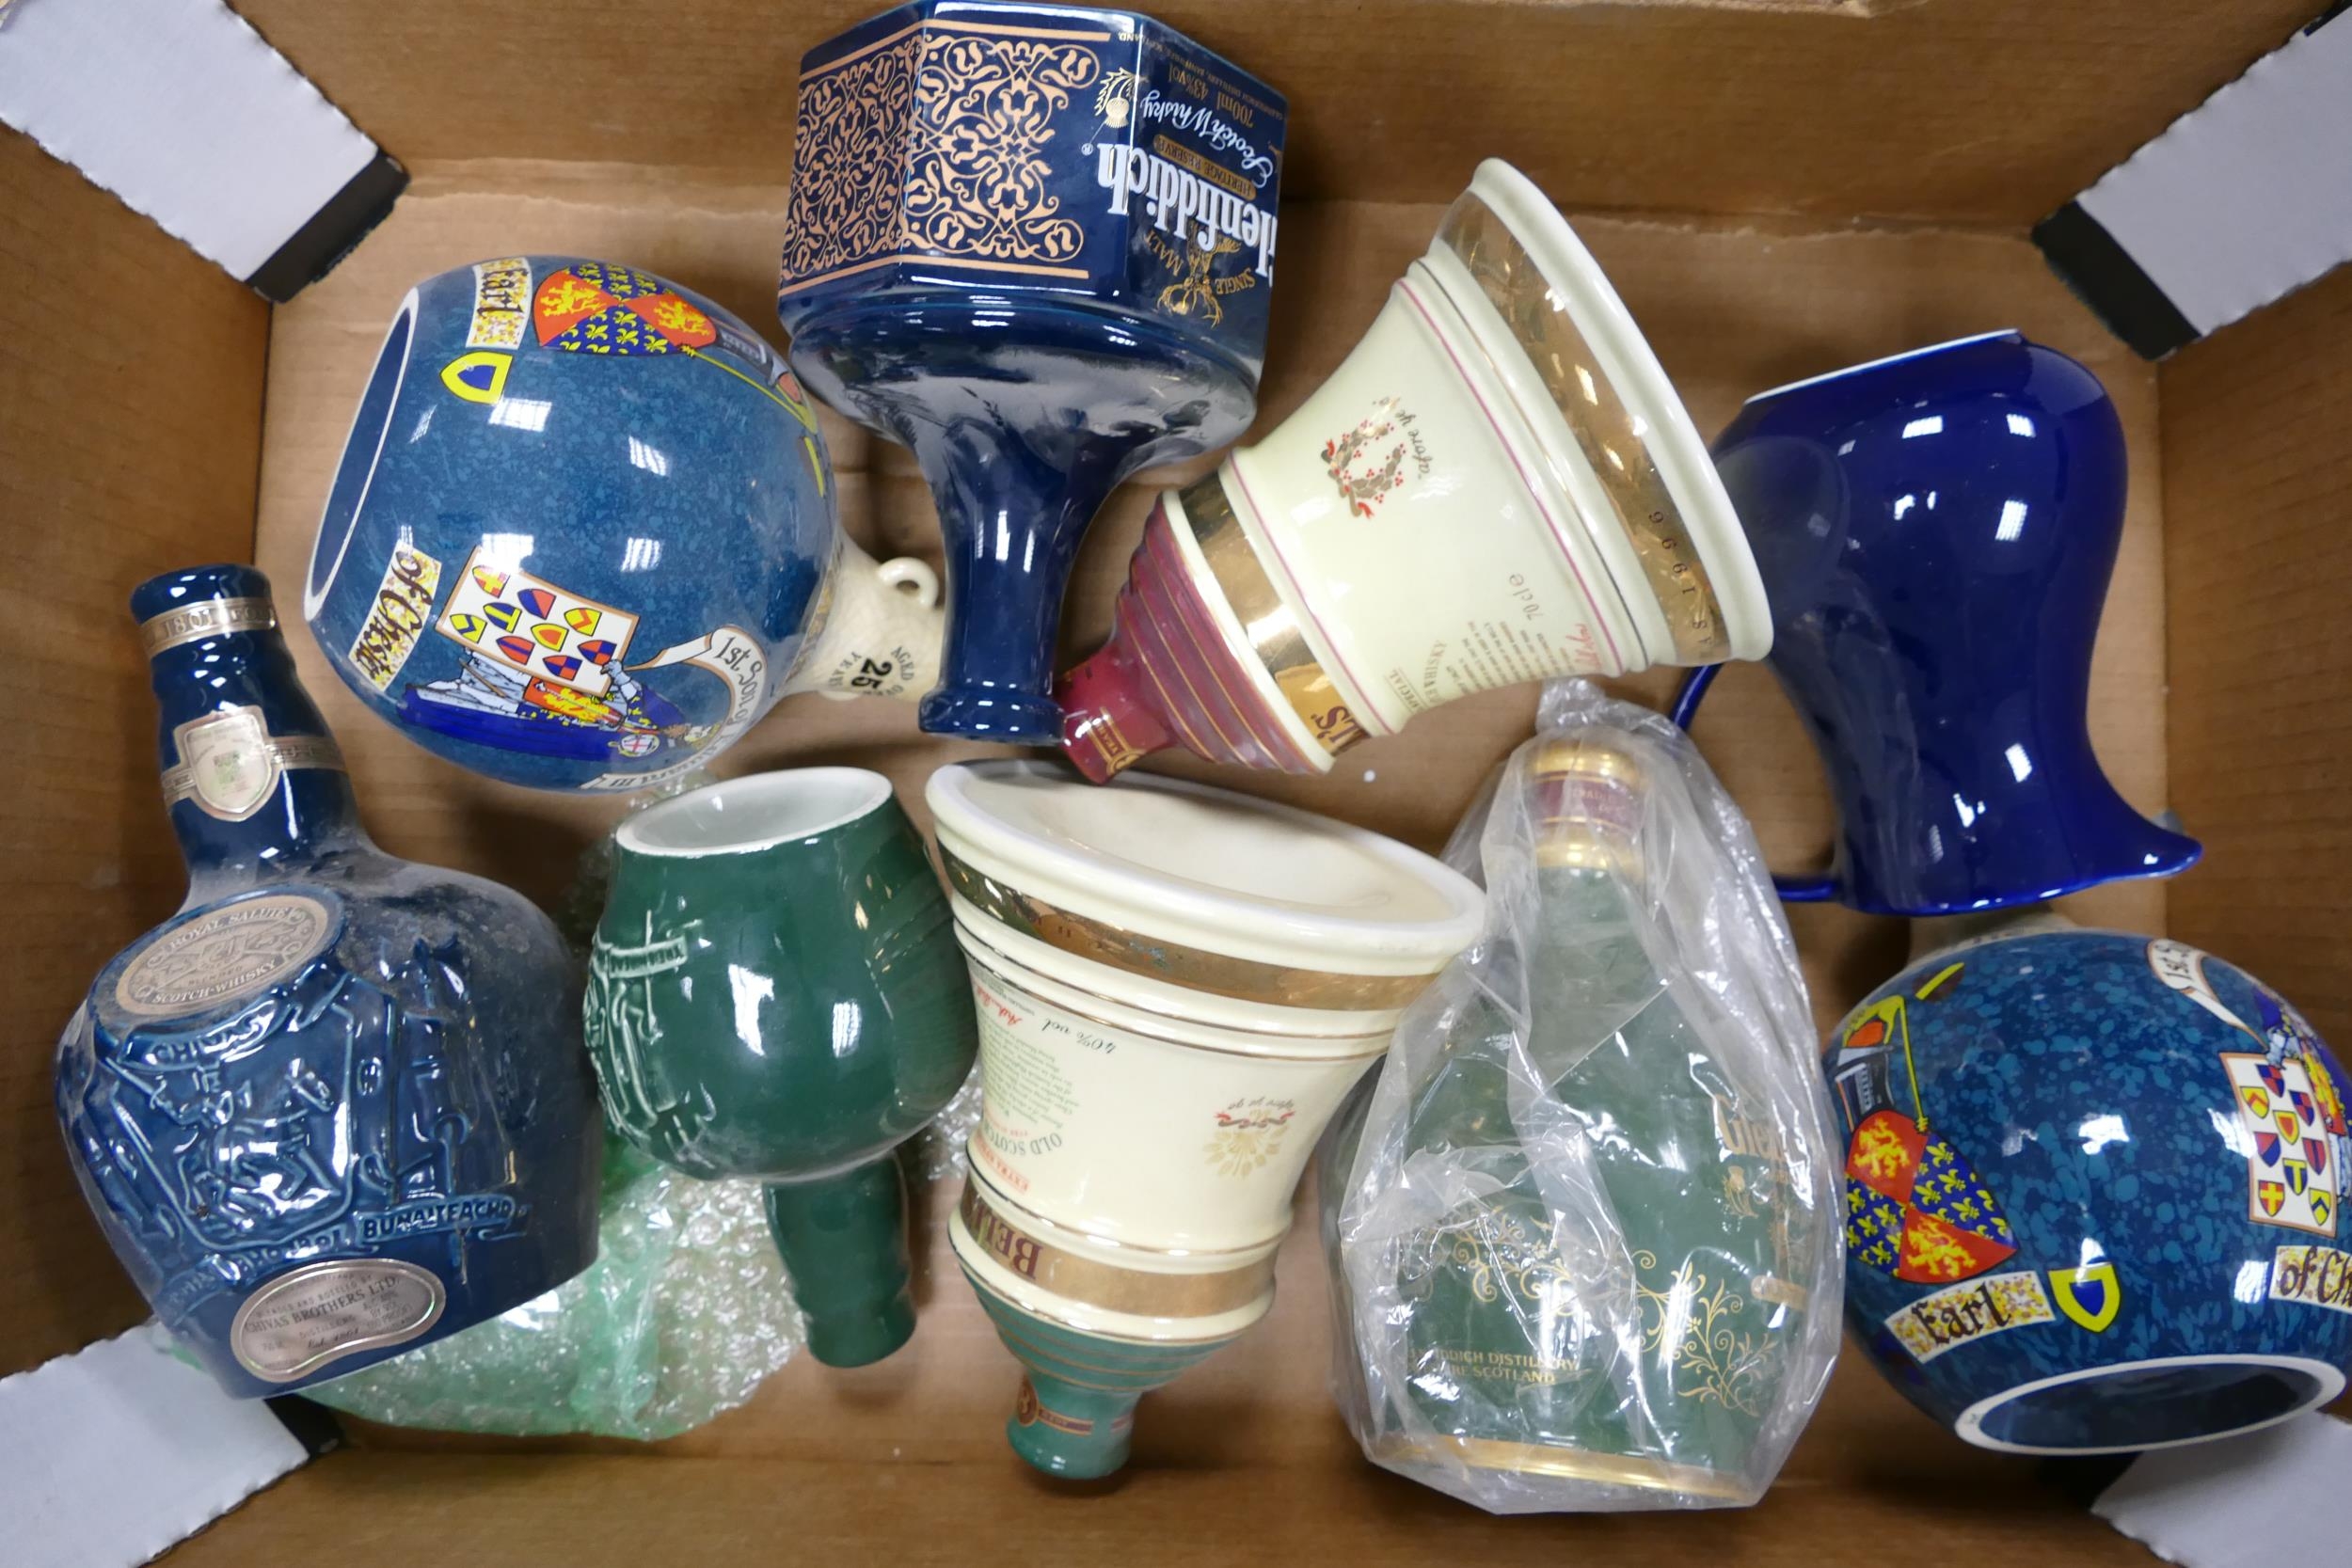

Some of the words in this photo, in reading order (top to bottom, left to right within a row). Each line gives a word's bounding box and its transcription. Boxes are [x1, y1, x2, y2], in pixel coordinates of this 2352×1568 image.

[1139, 88, 1213, 138] Whisky
[1217, 91, 1254, 128] 700ml
[1158, 135, 1202, 170] RESERVE
[1210, 117, 1273, 188] Scotch
[1204, 158, 1253, 197] HERITAGE
[1097, 143, 1278, 287] lenfiddich
[1144, 229, 1185, 277] MALT
[478, 267, 530, 317] Earl
[1215, 267, 1255, 294] SINGLE
[391, 550, 434, 606] of
[356, 590, 423, 680] Chester
[850, 657, 893, 689] 25
[890, 645, 914, 681] AGED
[168, 917, 223, 949] ROYAL
[1041, 1018, 1072, 1035] vol
[1077, 1031, 1118, 1054] 40%
[1030, 1132, 1062, 1156] OLD
[2280, 1246, 2318, 1299] of
[292, 1291, 365, 1324] BROTHERS
[1911, 1281, 2012, 1346] Earl
